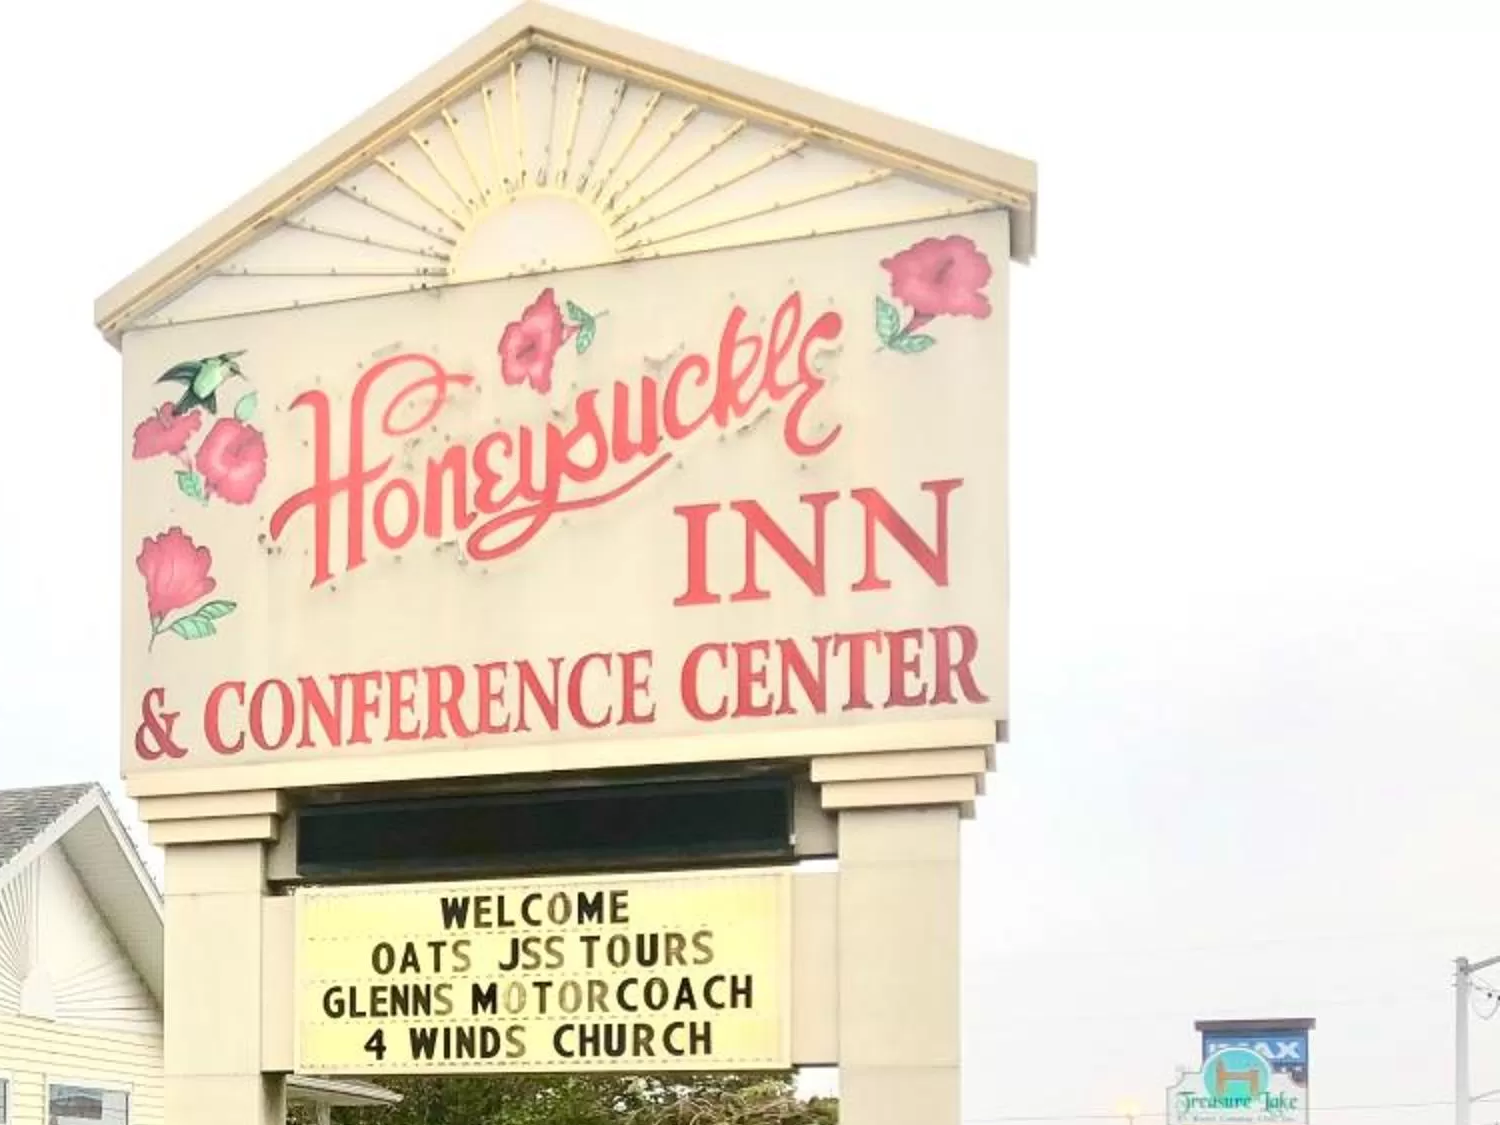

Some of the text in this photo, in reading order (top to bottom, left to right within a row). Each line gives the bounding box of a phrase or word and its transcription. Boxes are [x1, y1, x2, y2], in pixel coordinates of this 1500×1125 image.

[271, 290, 845, 589] Honeysuckle
[672, 477, 965, 609] INN
[133, 623, 990, 762] & CONFERENCE CENTER
[440, 889, 630, 930] WELCOME
[371, 930, 715, 976] OATS JSS TOURS
[322, 974, 754, 1020] GLENNS MOTORCOACH
[363, 1021, 713, 1062] 4 WINDS CHURCH
[1175, 1091, 1252, 1113] Treasure
